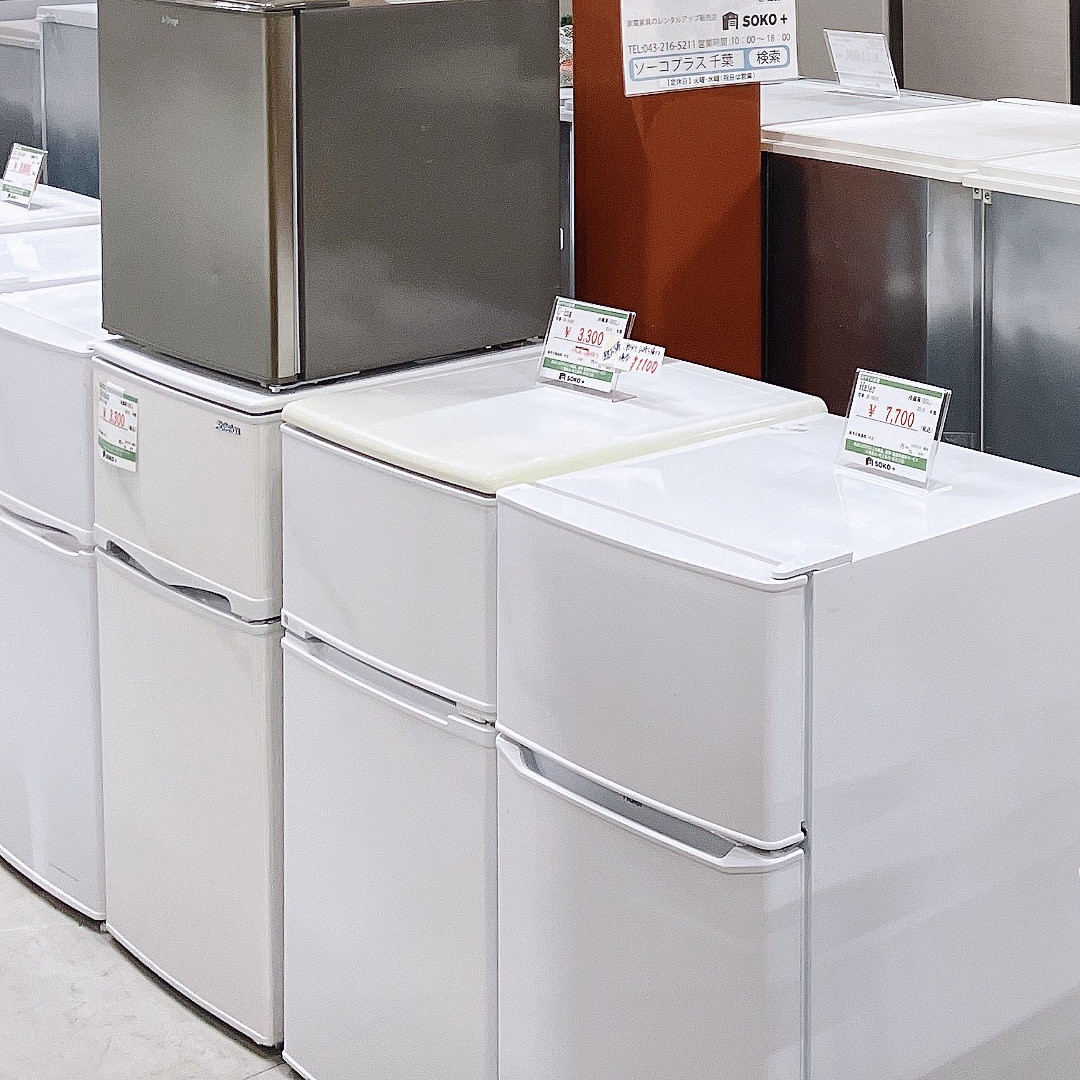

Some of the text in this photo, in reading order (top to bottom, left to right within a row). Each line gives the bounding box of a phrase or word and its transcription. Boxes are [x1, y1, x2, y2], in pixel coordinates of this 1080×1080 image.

[742, 13, 777, 28] SOKO
[756, 49, 781, 65] 検索
[867, 403, 877, 417] ¥
[874, 460, 892, 471] SOKO
